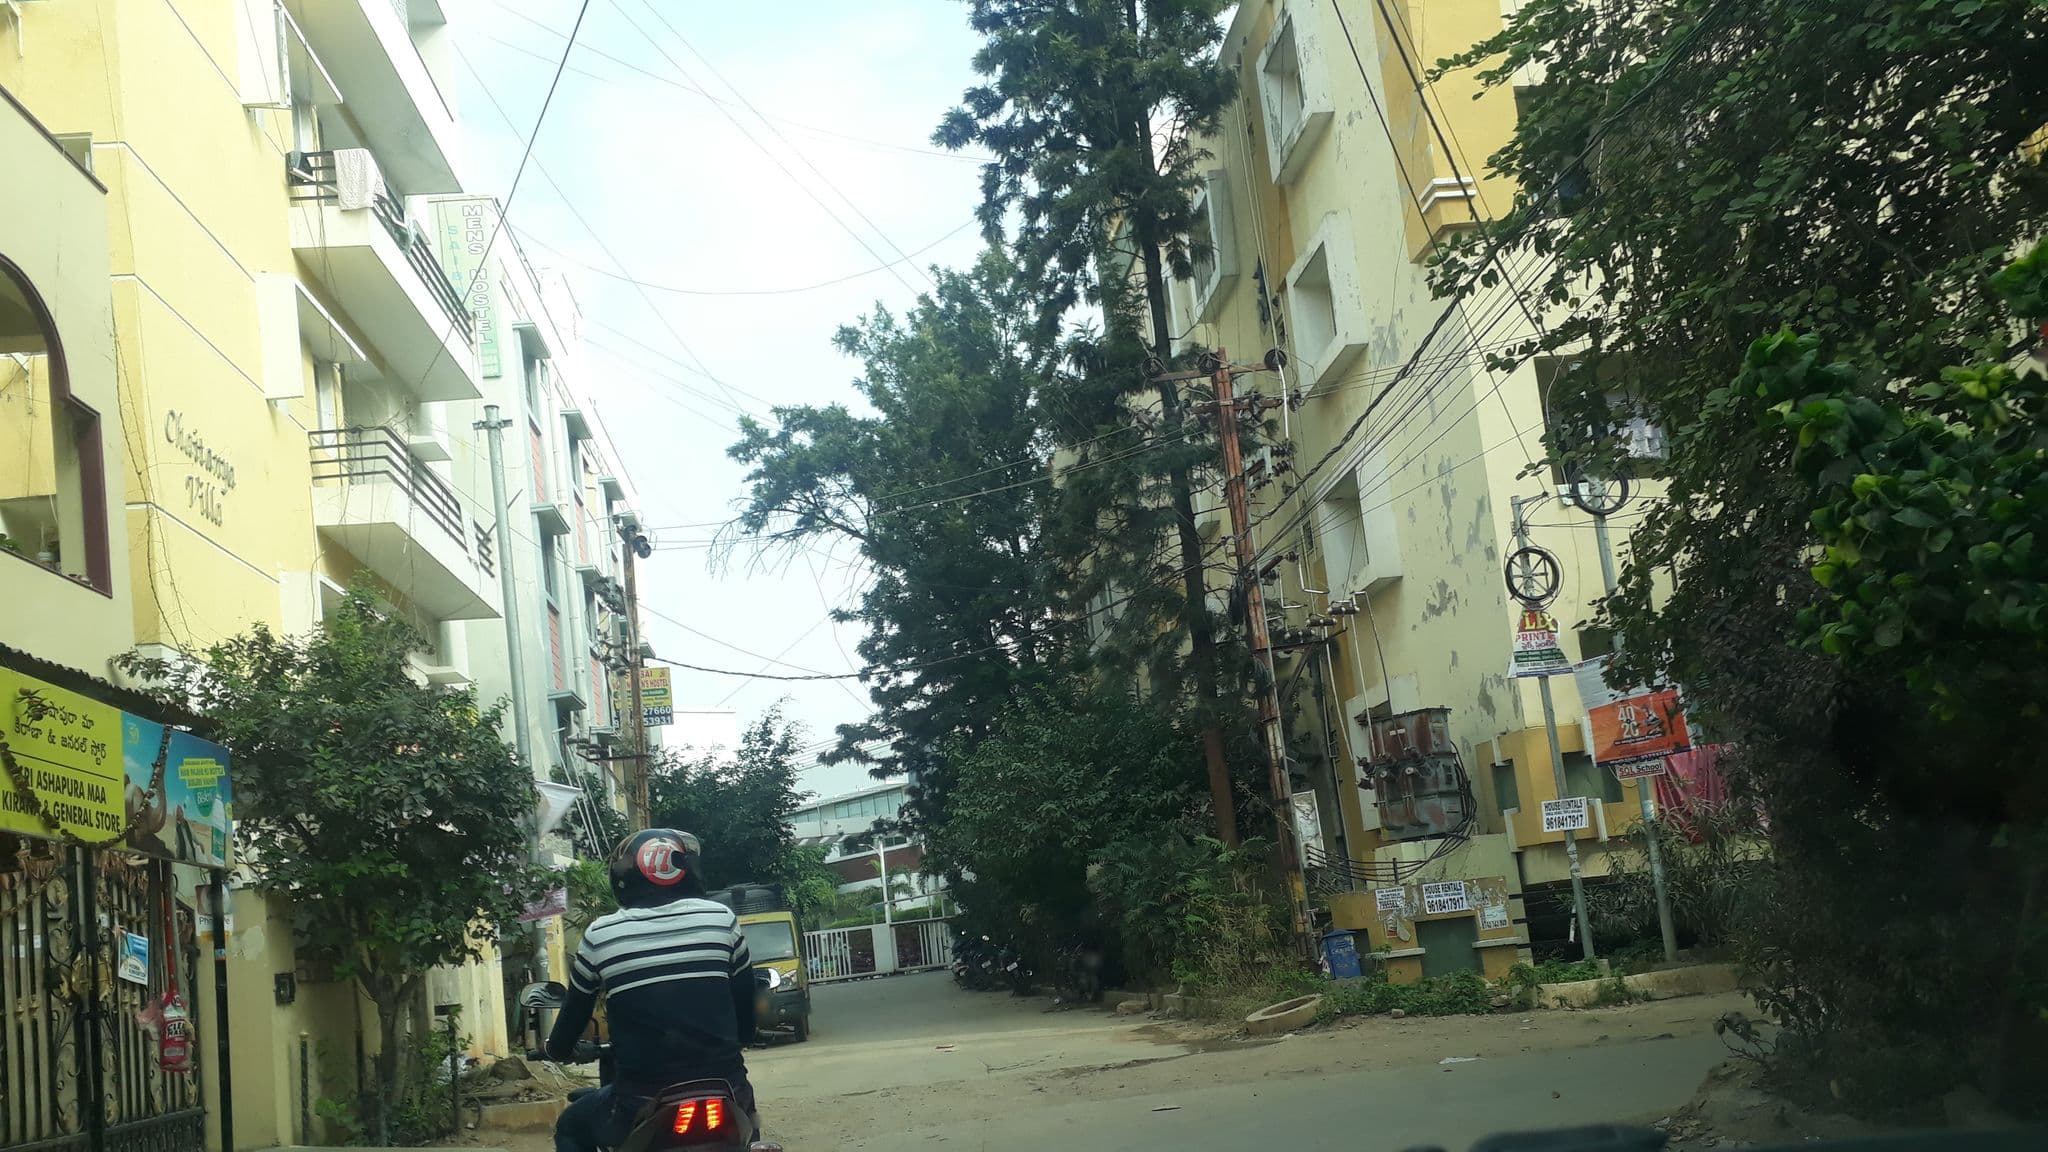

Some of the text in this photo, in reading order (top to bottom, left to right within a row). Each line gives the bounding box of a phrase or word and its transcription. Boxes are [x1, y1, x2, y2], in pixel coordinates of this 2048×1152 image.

[462, 205, 493, 345] MENS HOSTEL
[185, 475, 224, 528] Villa
[1636, 762, 1662, 772] School
[36, 770, 85, 800] ASHAPURA
[88, 783, 107, 804] MAA
[1560, 799, 1583, 810] NTALS
[53, 801, 93, 827] GENERAL
[95, 811, 121, 833] STORE
[1424, 884, 1441, 895] HOUSE
[1441, 881, 1462, 893] RENTALS
[1427, 897, 1464, 912] 9618417917
